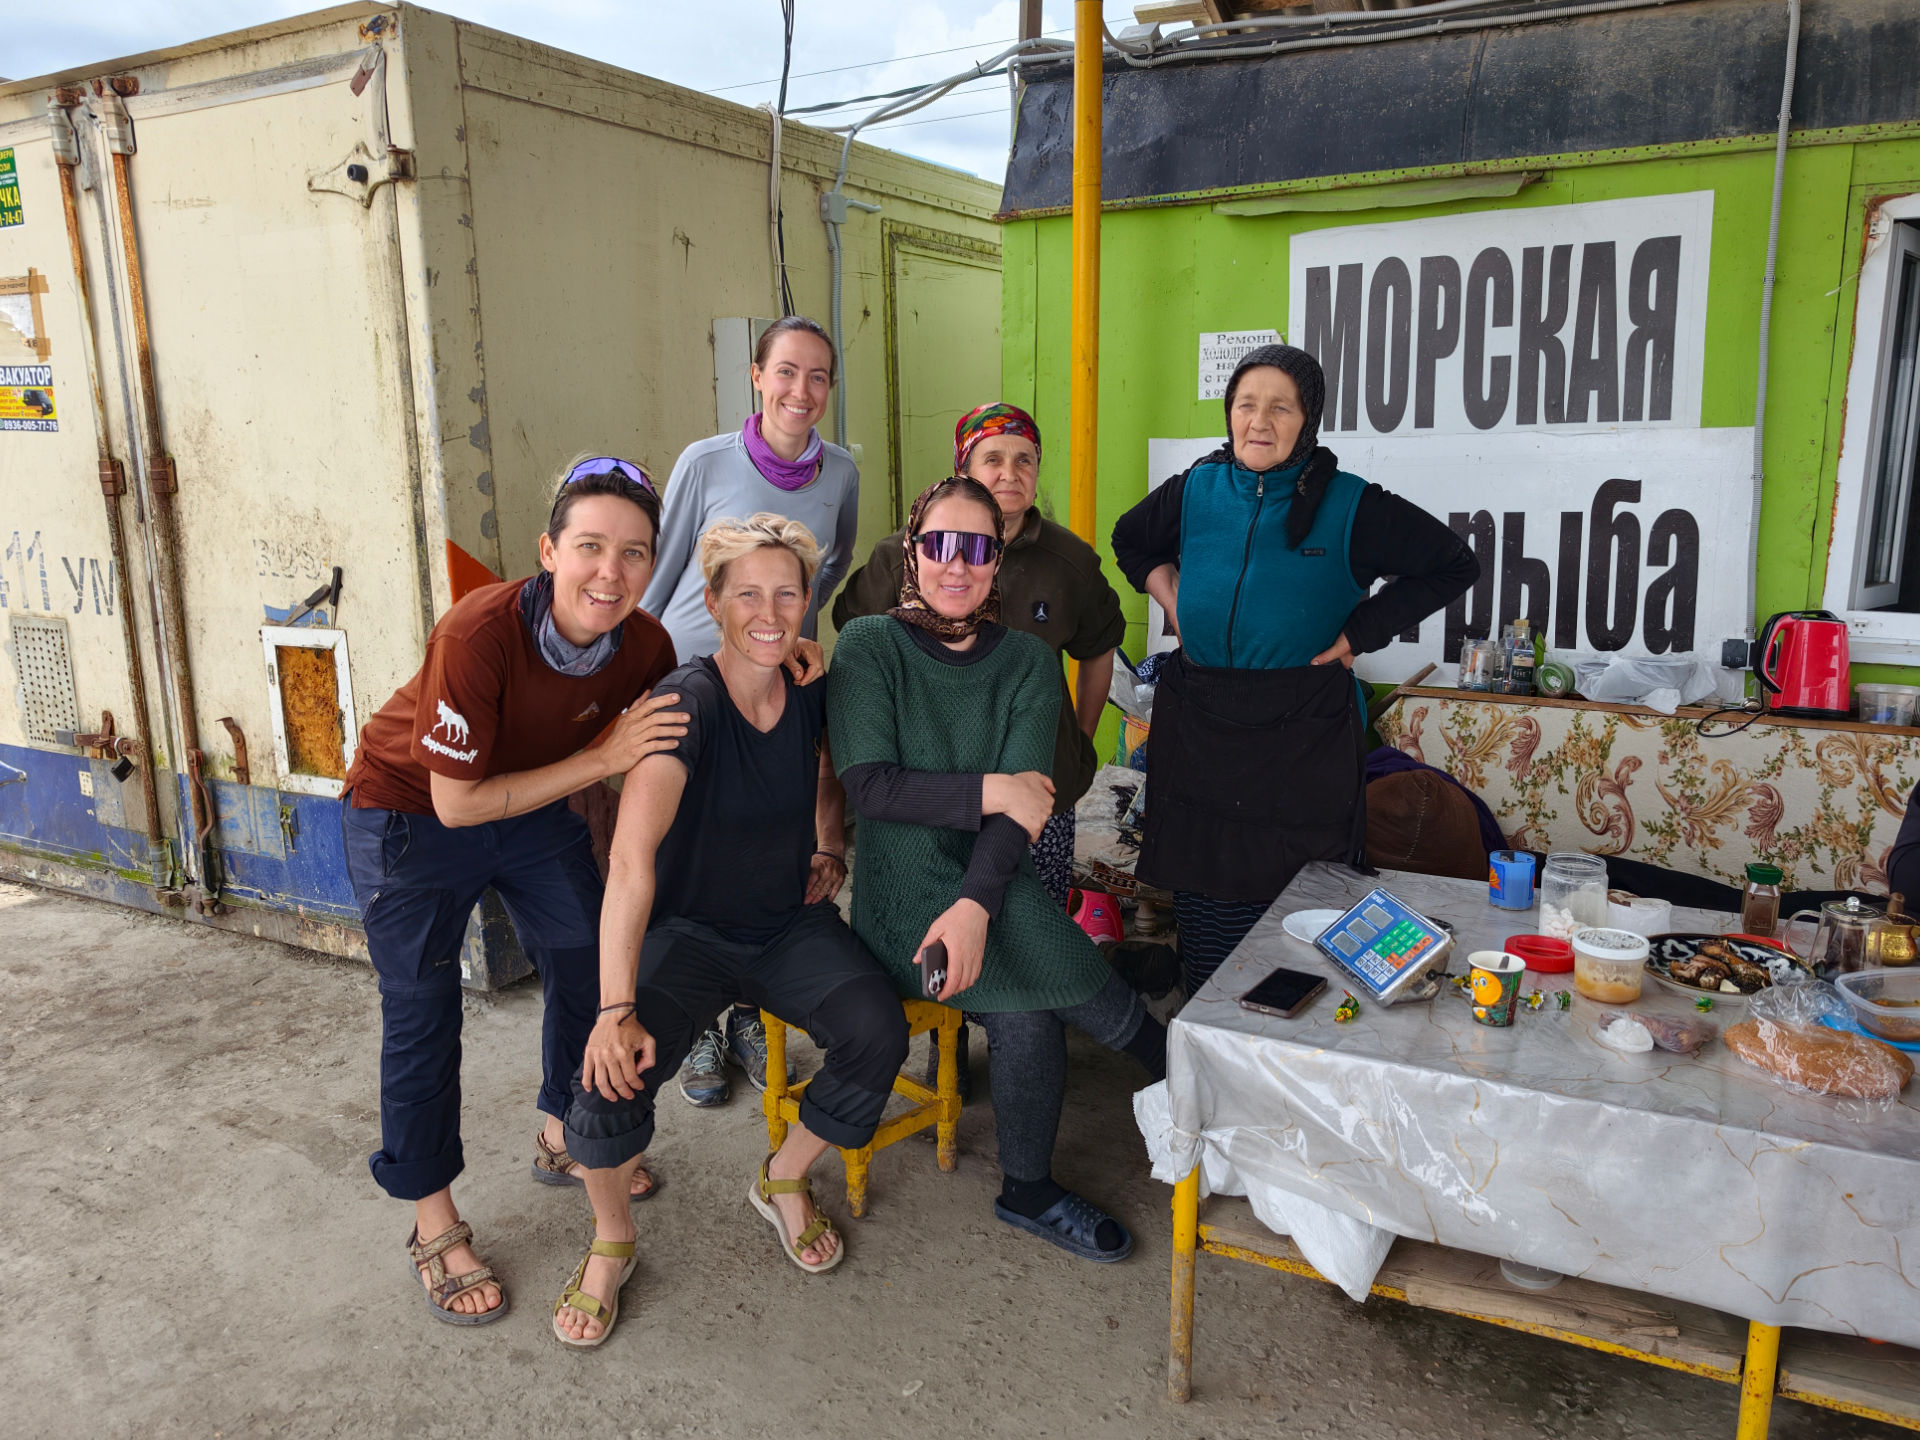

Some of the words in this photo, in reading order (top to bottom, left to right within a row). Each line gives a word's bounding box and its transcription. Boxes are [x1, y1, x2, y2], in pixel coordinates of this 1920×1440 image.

[0, 367, 51, 385] ВАКУАТОР
[1217, 334, 1273, 345] Ремонт
[1305, 236, 1682, 433] МОРСКАЯ
[1443, 479, 1700, 664] рыба
